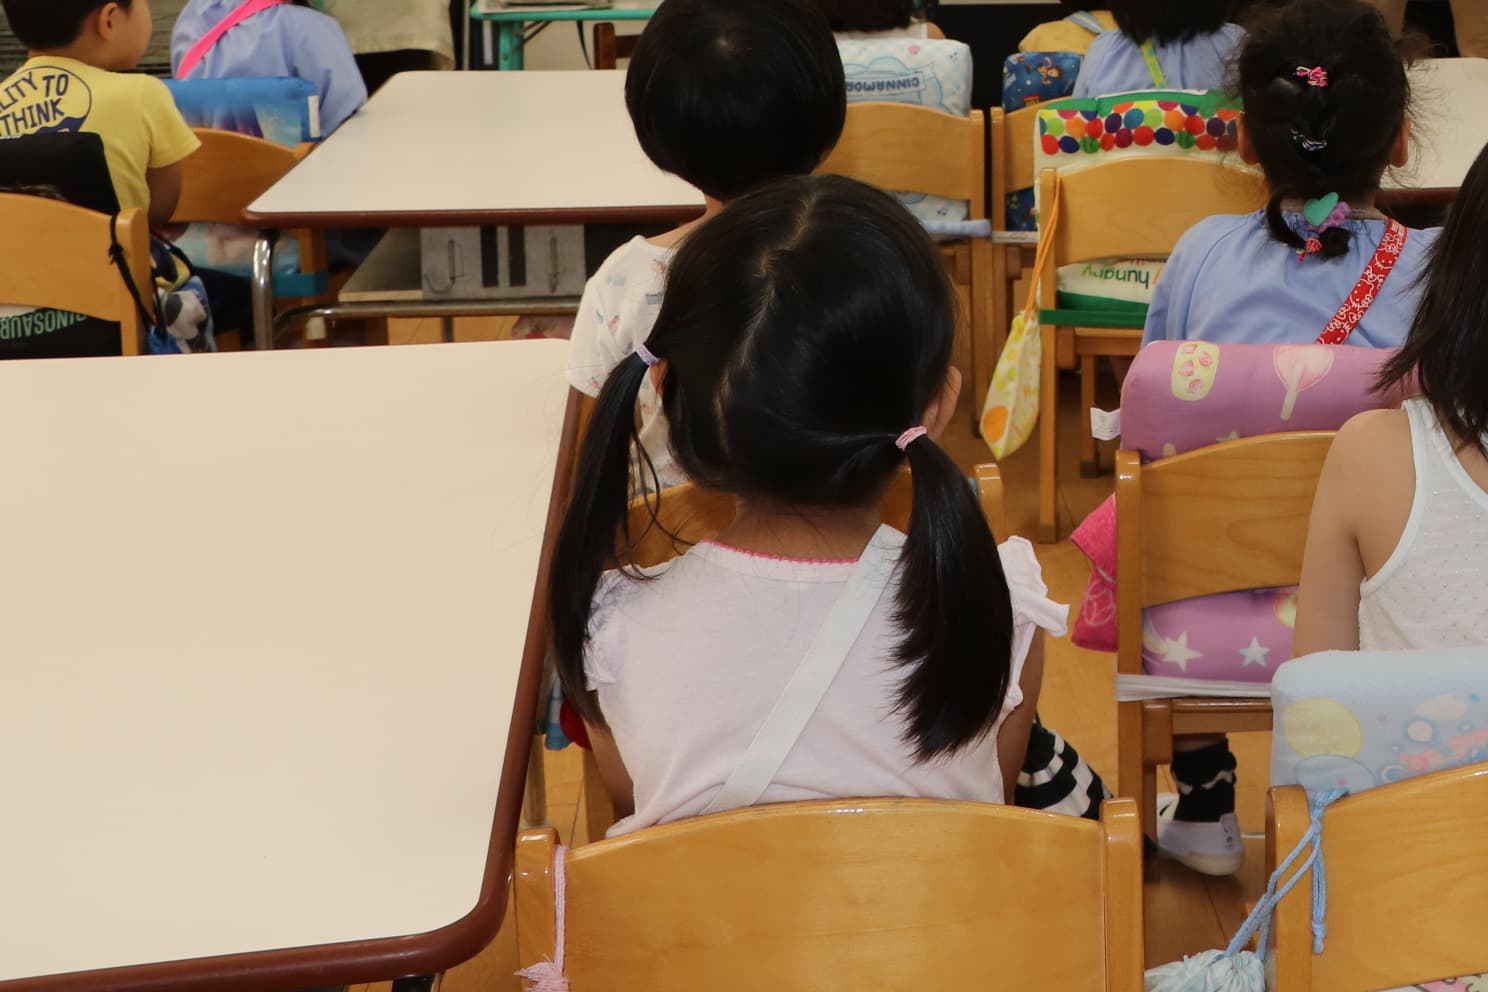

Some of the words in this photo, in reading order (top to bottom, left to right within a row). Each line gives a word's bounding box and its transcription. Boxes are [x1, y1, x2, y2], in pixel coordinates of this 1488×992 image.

[0, 71, 38, 112] LITY
[42, 73, 70, 98] TO
[0, 98, 65, 137] THINK
